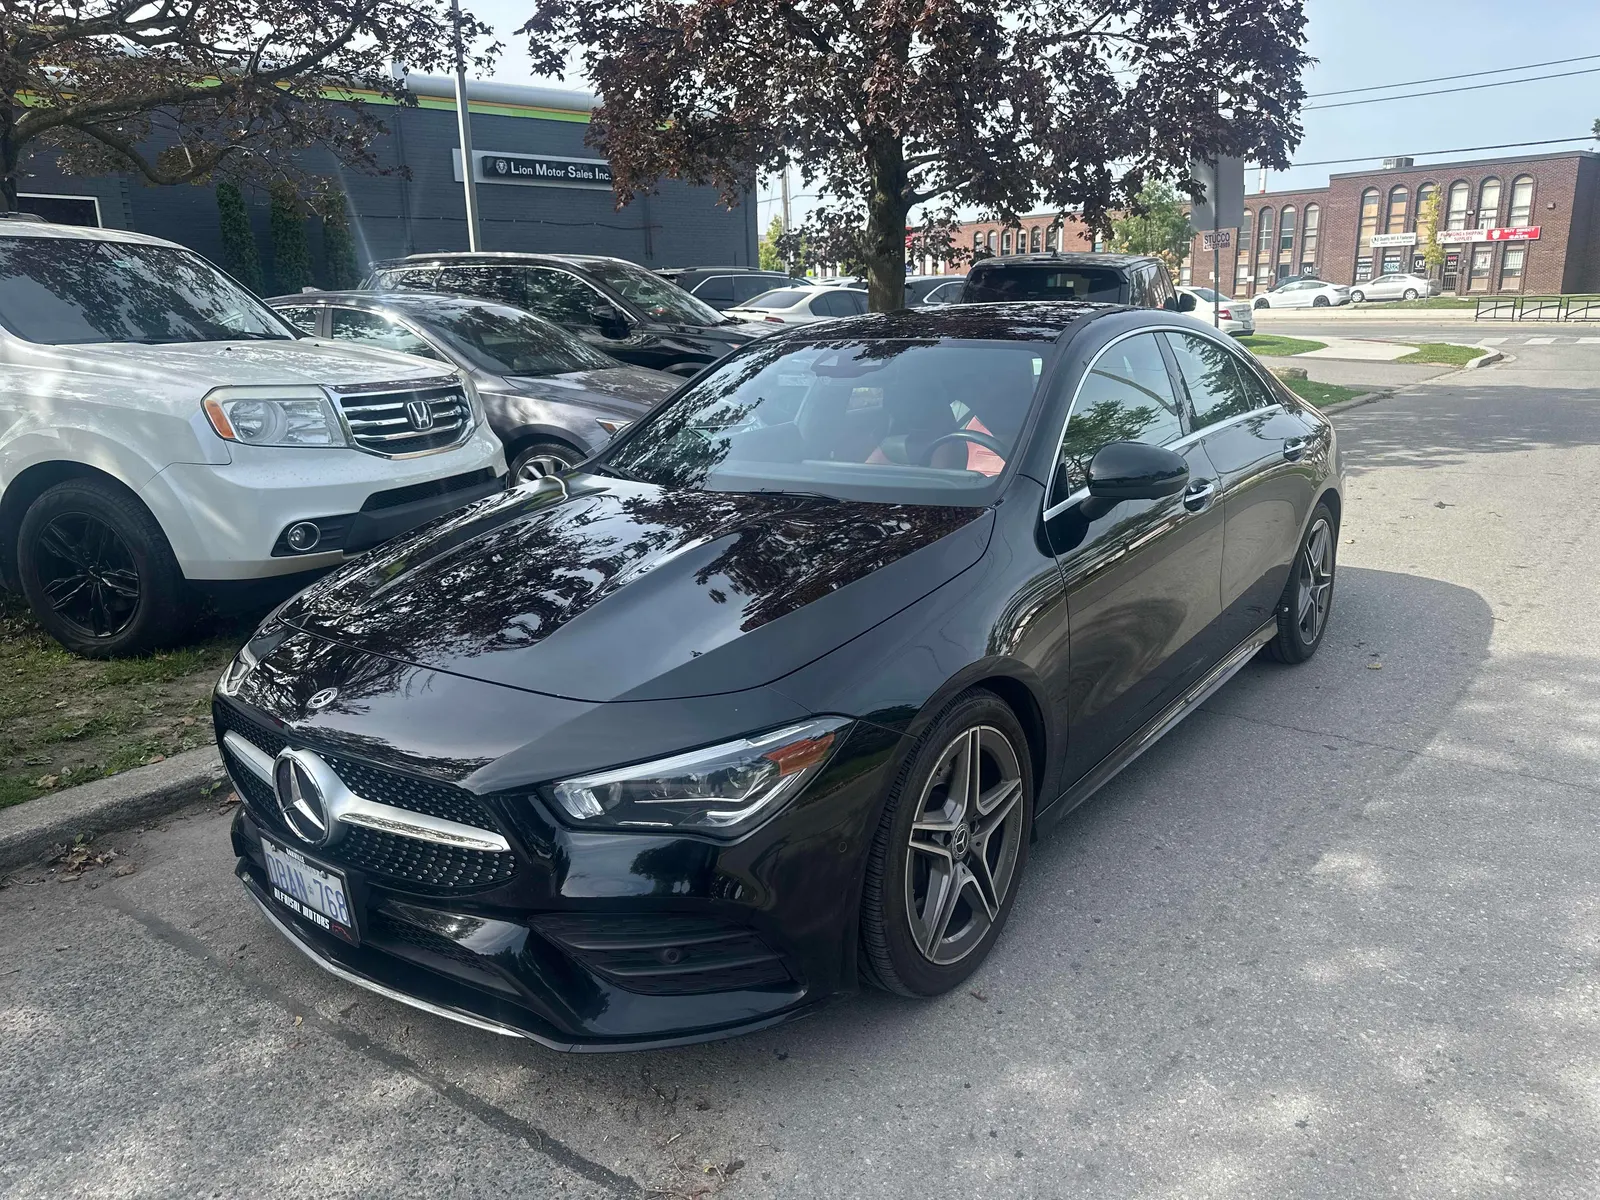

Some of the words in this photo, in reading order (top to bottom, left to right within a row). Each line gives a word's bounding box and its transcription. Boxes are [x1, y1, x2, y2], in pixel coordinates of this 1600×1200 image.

[510, 161, 533, 175] Lion
[535, 163, 565, 178] Motor
[567, 165, 593, 179] Sales
[595, 167, 612, 181] Inc.
[1204, 232, 1230, 245] STUCCO
[313, 878, 350, 925] 768
[302, 905, 330, 930] MOTORS
